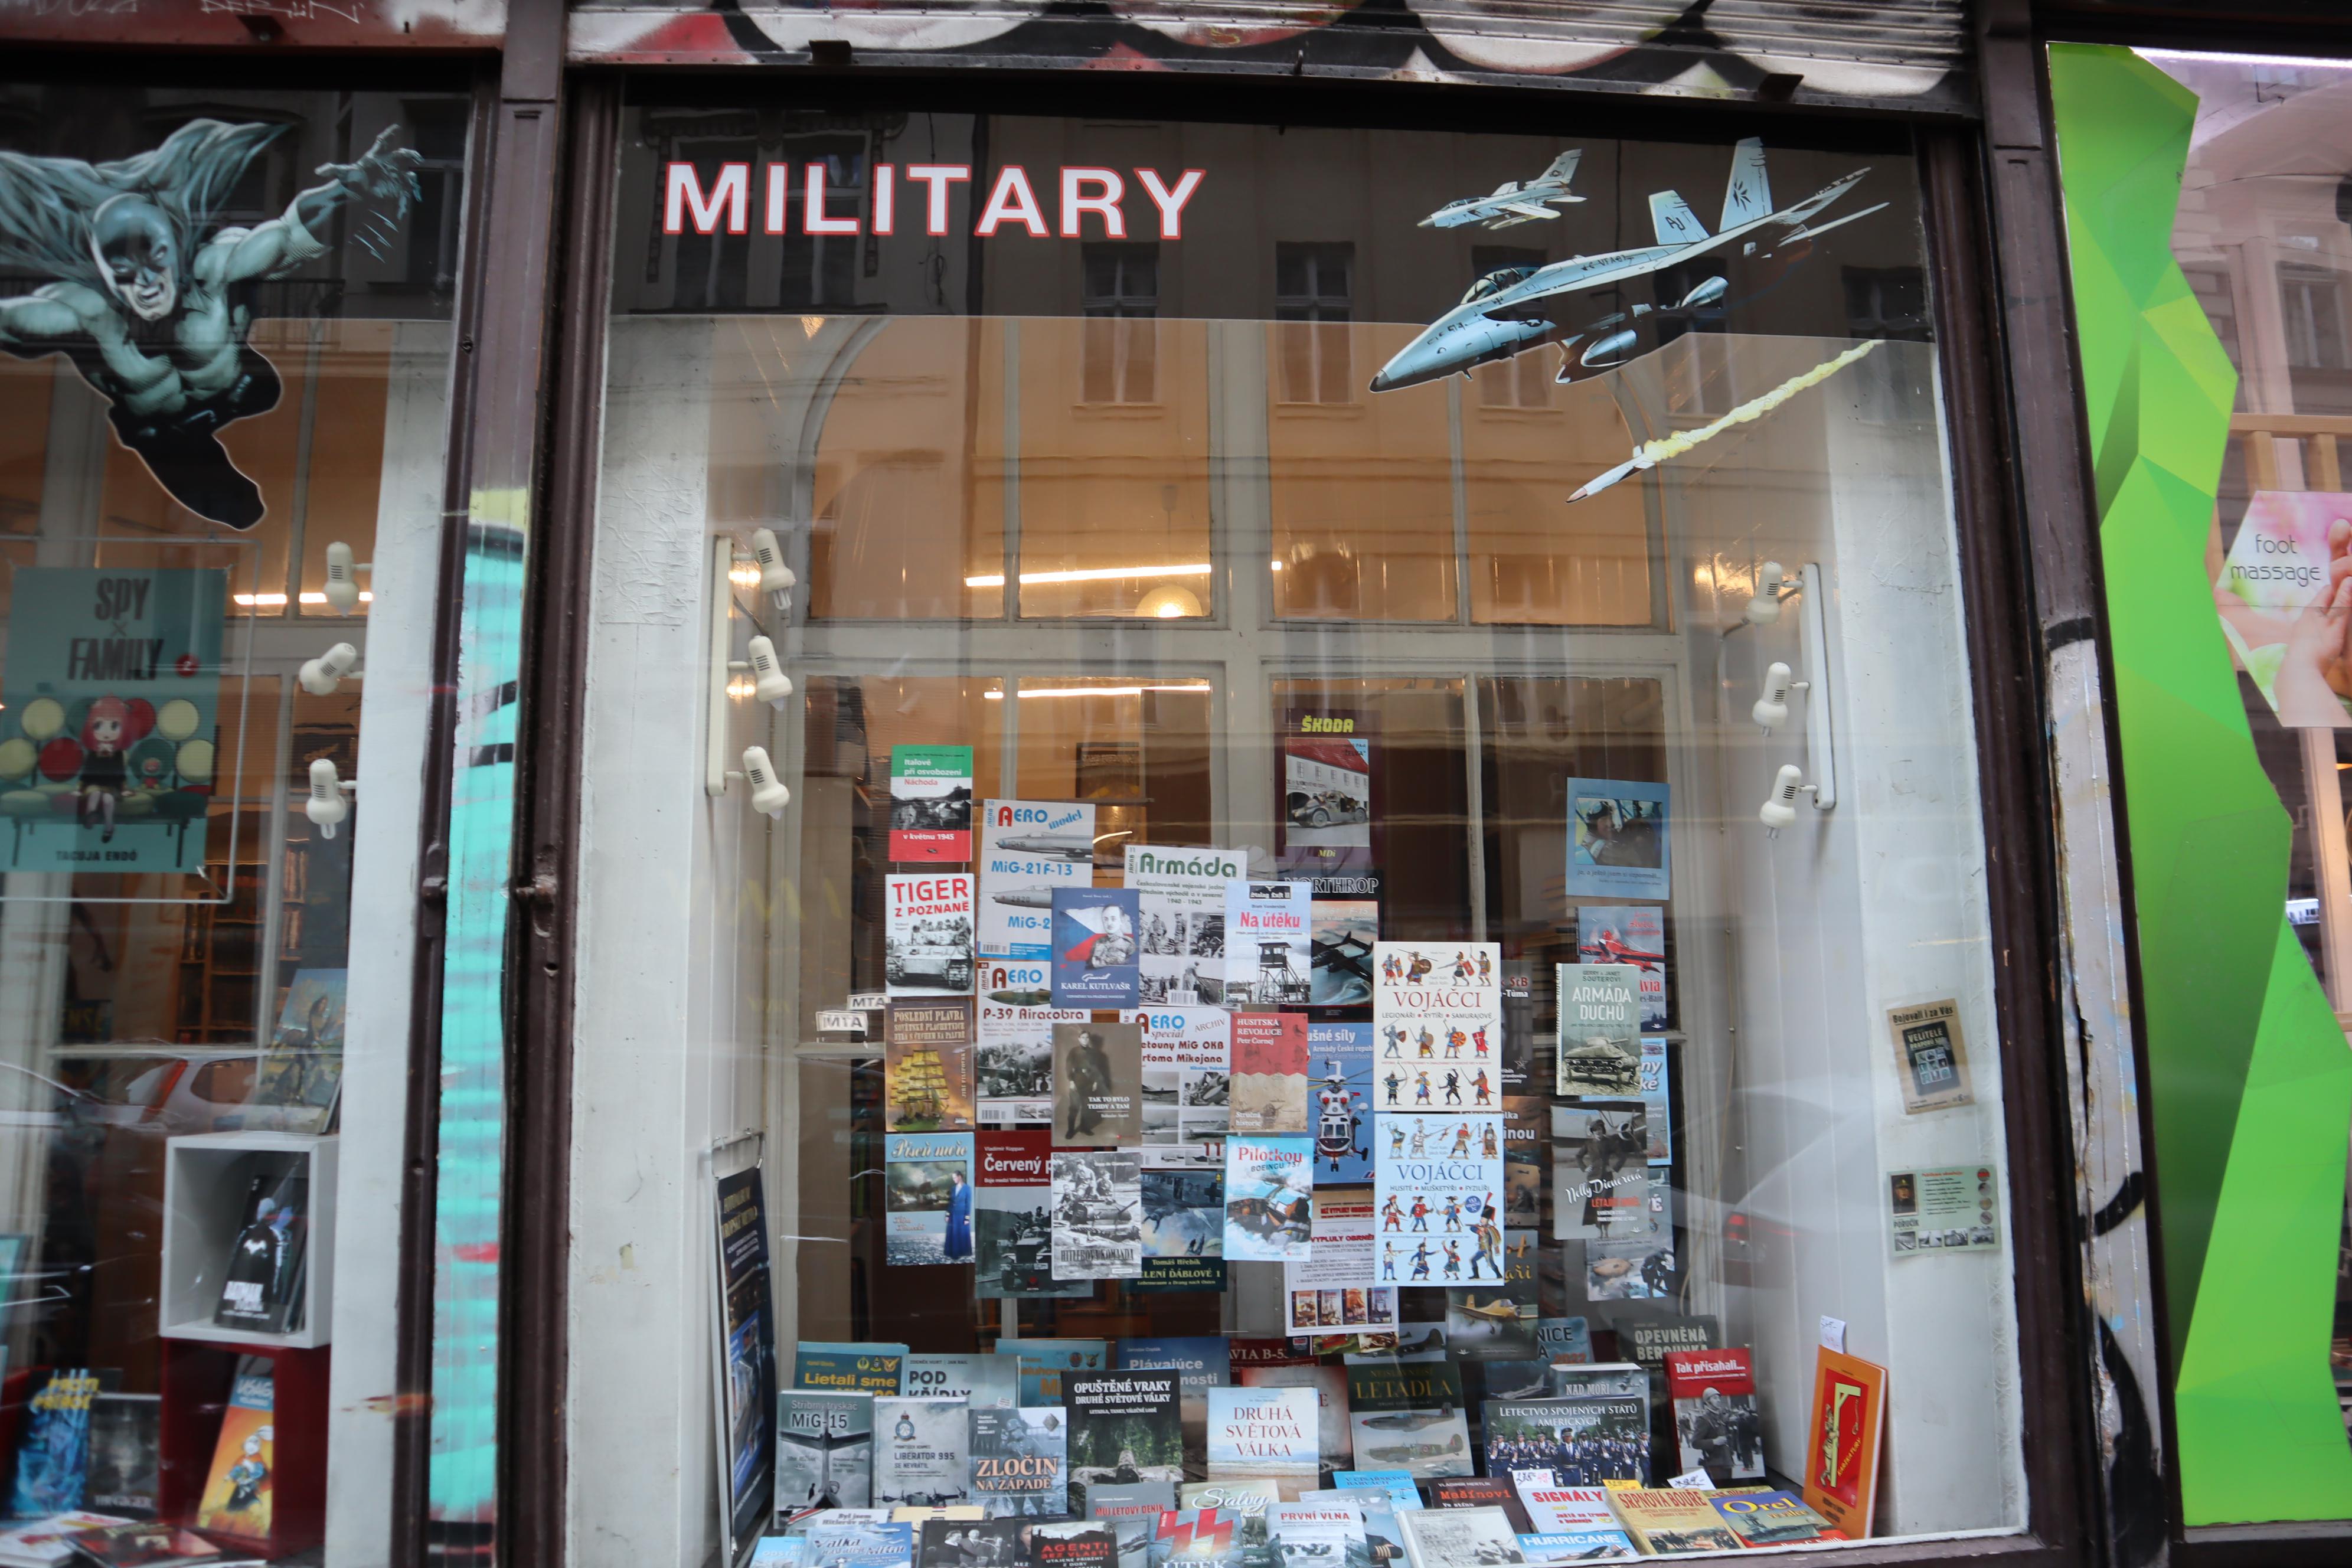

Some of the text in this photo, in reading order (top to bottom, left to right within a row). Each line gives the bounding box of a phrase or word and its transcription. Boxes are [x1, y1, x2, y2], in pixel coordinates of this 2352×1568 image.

[663, 162, 1206, 239] MILITARY
[2255, 534, 2297, 554] foot
[2230, 565, 2321, 587] massage
[94, 578, 151, 620] SPY
[67, 638, 164, 681] FAMILY
[182, 661, 192, 671] 2
[1301, 715, 1354, 733] ŠKODA
[998, 806, 1048, 827] AERO
[1048, 809, 1082, 829] model
[56, 851, 101, 862] TACUJA
[991, 860, 1073, 876] MiG-21F-13
[1139, 852, 1237, 878] Armáda
[892, 878, 969, 903] TIGER
[1284, 877, 1379, 894] RTHROP
[894, 907, 902, 917] Z
[1240, 912, 1301, 928] Na útěku
[1008, 916, 1050, 929] MiG-2
[992, 968, 1043, 988] AERO
[1089, 982, 1131, 990] KUTLVAŠR
[1393, 989, 1481, 1012] VOJÁČCI
[1572, 984, 1632, 1003] ARMÁDA
[894, 1010, 964, 1022] POSLEDNÍ PLAVBA
[984, 1008, 1083, 1020] P-39 Airacobra
[1451, 1011, 1492, 1020] SAMURAJOVÉ
[1580, 1002, 1624, 1021] DUCHŮ
[1135, 1012, 1185, 1034] AERO
[1194, 1018, 1226, 1033] ARCHIV
[1237, 1018, 1279, 1027] HUSITSKÁ
[1151, 1030, 1184, 1039] speciál
[1237, 1028, 1282, 1036] REVOLUCE
[1335, 1029, 1355, 1043] síly
[1202, 1041, 1224, 1050] OKB
[1176, 1054, 1223, 1064] Mikojana
[891, 1138, 968, 1159] Píseň moře
[1239, 1146, 1303, 1163] Pilotkou
[984, 1154, 1042, 1174] Červený
[1251, 1163, 1285, 1172] BOEINGU
[1396, 1161, 1484, 1184] VOJÁČCI
[1566, 1182, 1593, 1204] Nelly
[1169, 1268, 1212, 1278] ĎÁBLOVÉ
[1634, 1325, 1707, 1345] OPEVNĚNÁ
[1675, 1359, 1745, 1375] Tak přisahali...
[804, 1373, 897, 1387] Lietali sme
[909, 1371, 946, 1384] POD
[1074, 1378, 1171, 1394] OPUŠTĚNÉ VRAKY
[1355, 1379, 1453, 1399] LETADLA
[1566, 1383, 1610, 1396] NAD MOŘI
[1075, 1392, 1171, 1405] DRUHÉ SVĚTOVÉ VÁLKY
[1234, 1405, 1293, 1420] DRUHÁ
[1500, 1403, 1638, 1417] LETECTVO SPOJENÝCH STÁTŮ
[792, 1413, 847, 1428] MiG-15
[1537, 1417, 1601, 1426] AMERICKÝCH
[1226, 1423, 1302, 1439] SVĚTOVÁ
[1236, 1440, 1292, 1456] VÁLKA
[894, 1452, 955, 1461] LIBERATOR 995
[976, 1455, 1059, 1476] ZLOČIN
[976, 1478, 1052, 1491] NA ZÁPADĚ
[1191, 1488, 1270, 1512] Salvy
[1439, 1489, 1511, 1500] Mašínovi
[1532, 1491, 1605, 1502] SIGNÁLY
[1618, 1489, 1708, 1510] SRPNOVÁ BOUŘE
[1722, 1498, 1798, 1514] Orel
[1280, 1511, 1317, 1520] PRVNÍ
[1041, 1543, 1109, 1553] AGENTI
[1523, 1534, 1622, 1546] HURRICANE
